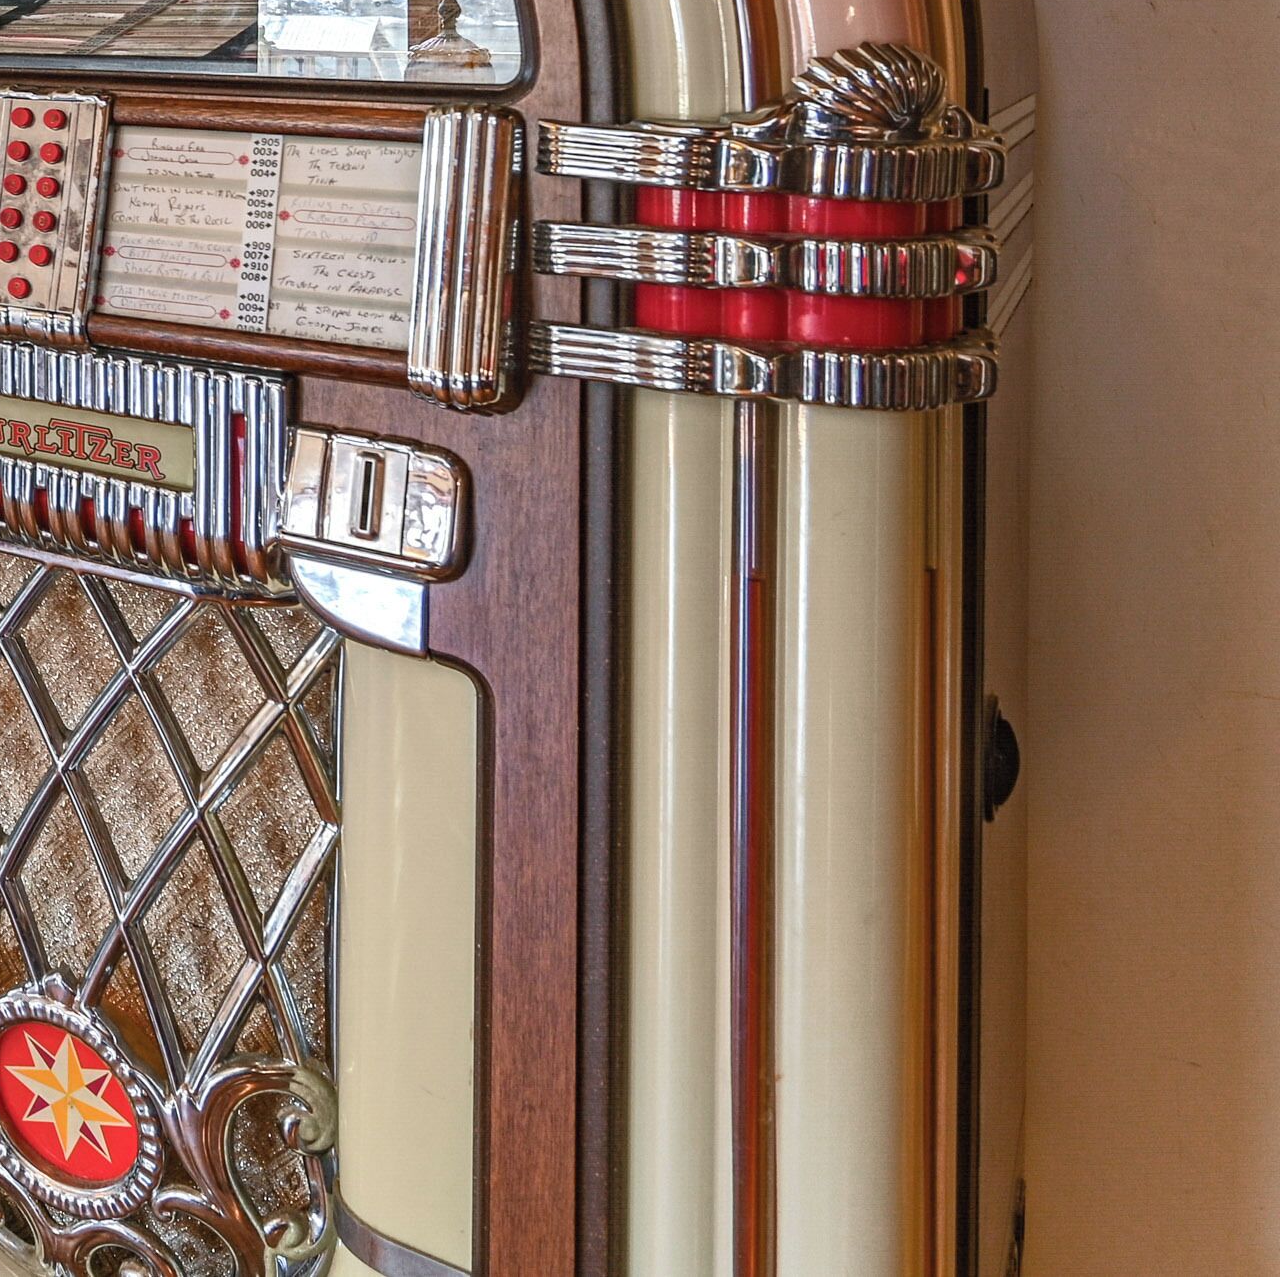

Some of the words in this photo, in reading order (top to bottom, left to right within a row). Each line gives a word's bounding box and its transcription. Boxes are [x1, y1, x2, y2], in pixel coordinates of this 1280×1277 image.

[261, 138, 280, 147] 905
[253, 147, 273, 155] 003
[258, 159, 278, 168] 906
[250, 169, 271, 177] 004
[256, 189, 275, 198] 907
[247, 199, 268, 208] 005
[253, 210, 273, 219] 908
[246, 220, 266, 229] 006
[251, 241, 271, 251] 909
[244, 251, 263, 260] 007
[249, 262, 269, 271] 910
[241, 272, 261, 282] 008
[247, 293, 265, 302] 001
[238, 303, 258, 312] 009
[245, 315, 264, 325] 002
